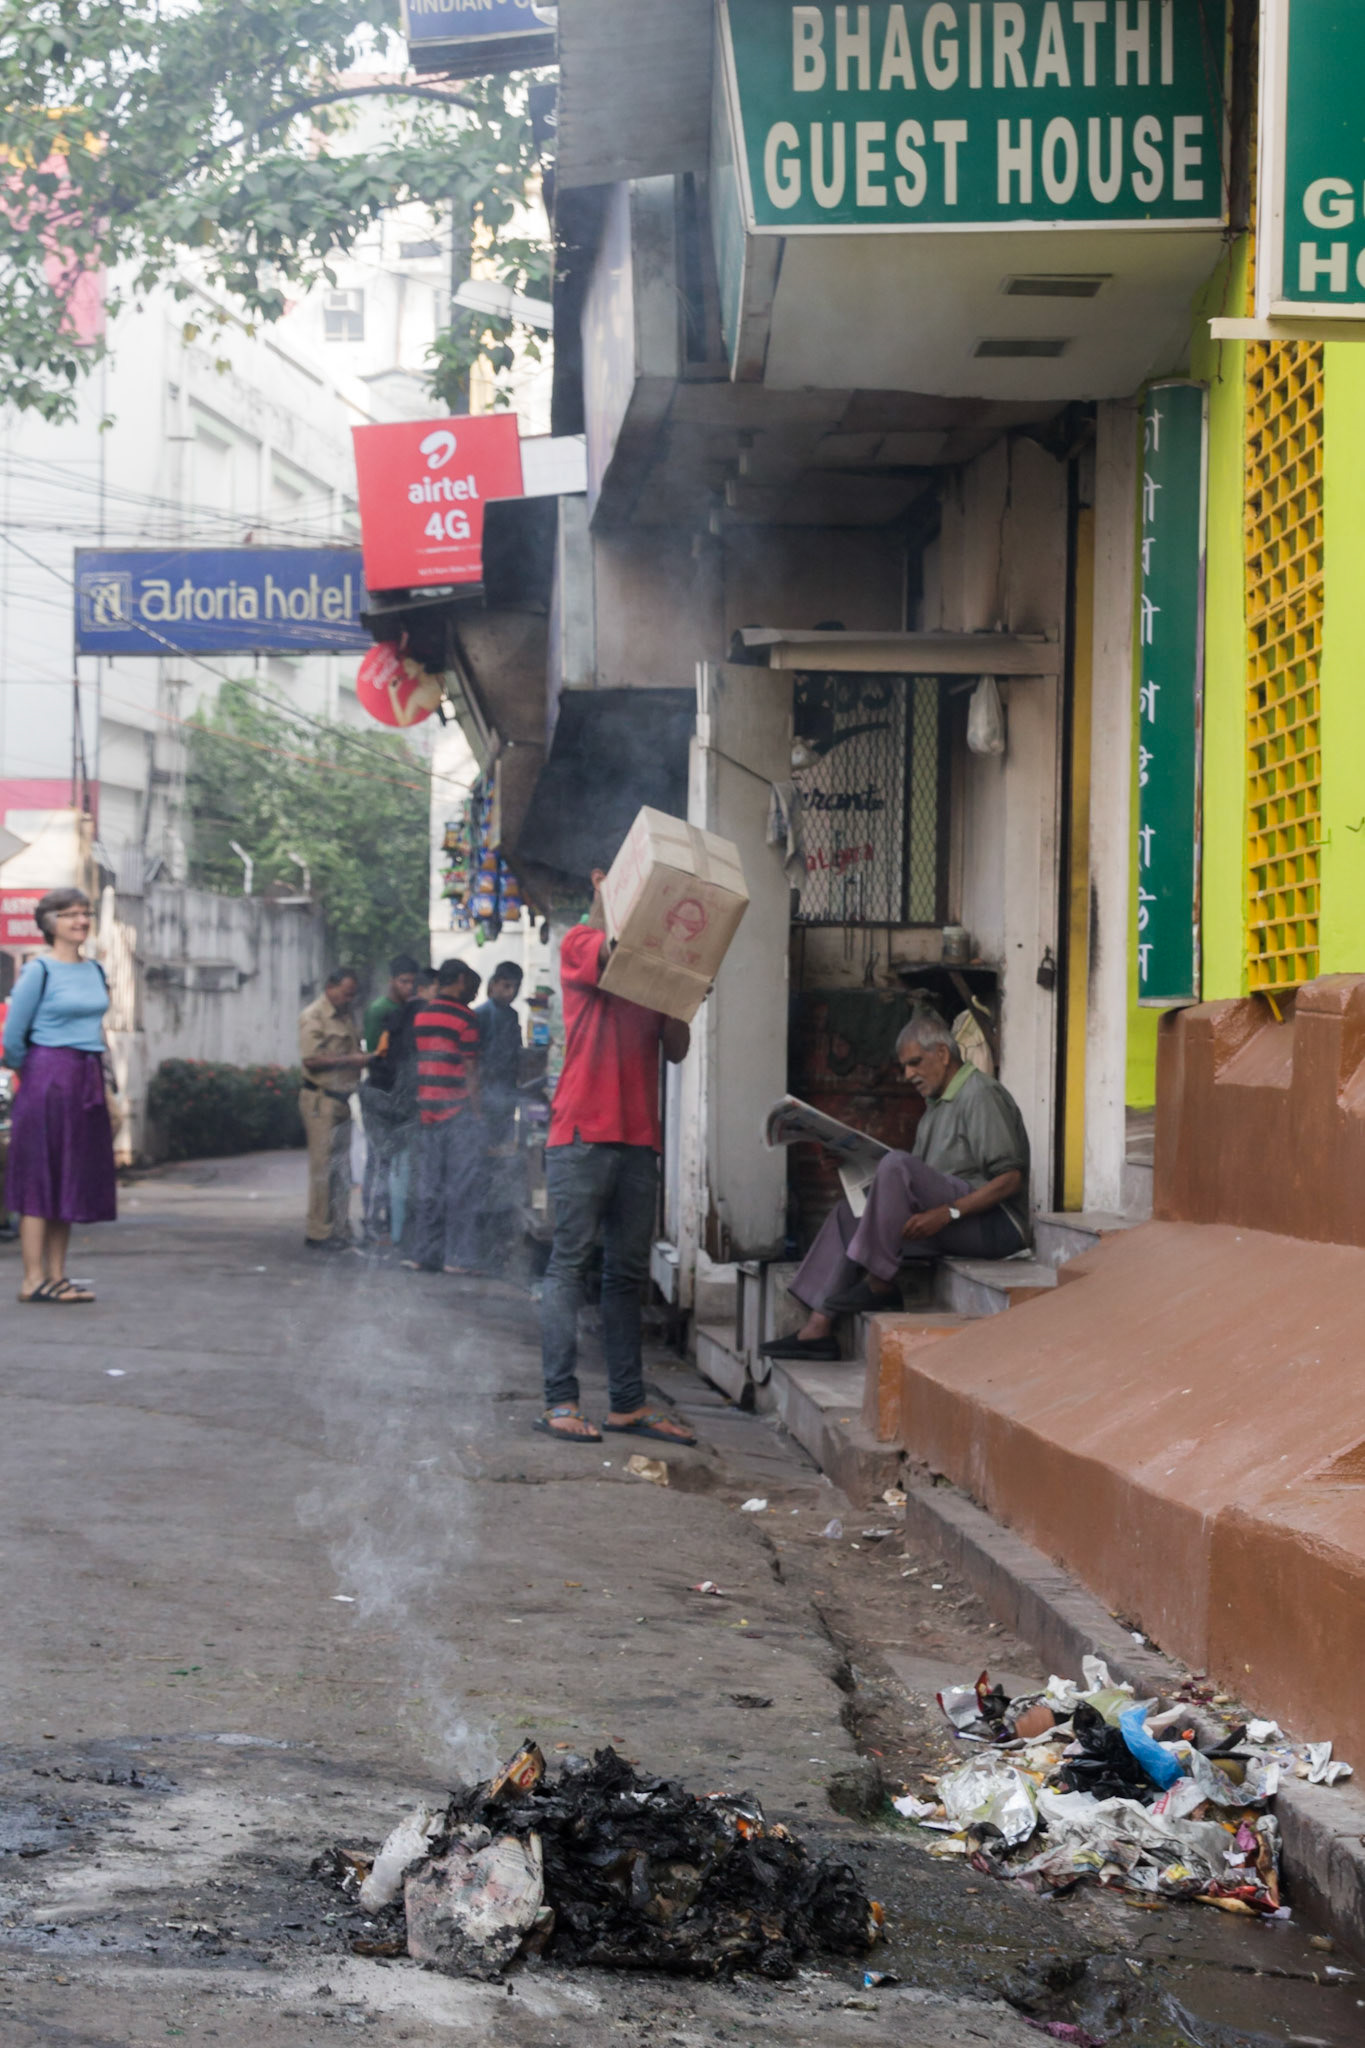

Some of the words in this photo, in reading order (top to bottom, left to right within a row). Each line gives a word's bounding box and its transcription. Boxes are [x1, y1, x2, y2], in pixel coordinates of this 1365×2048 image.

[792, 1, 1175, 92] BHAGIRATHI
[763, 119, 968, 210] GUEST
[997, 115, 1204, 205] HOUSE
[1303, 177, 1365, 229] G
[1299, 242, 1365, 292] H
[408, 474, 479, 504] airtel
[424, 508, 471, 541] 4G
[265, 573, 352, 621] hotel
